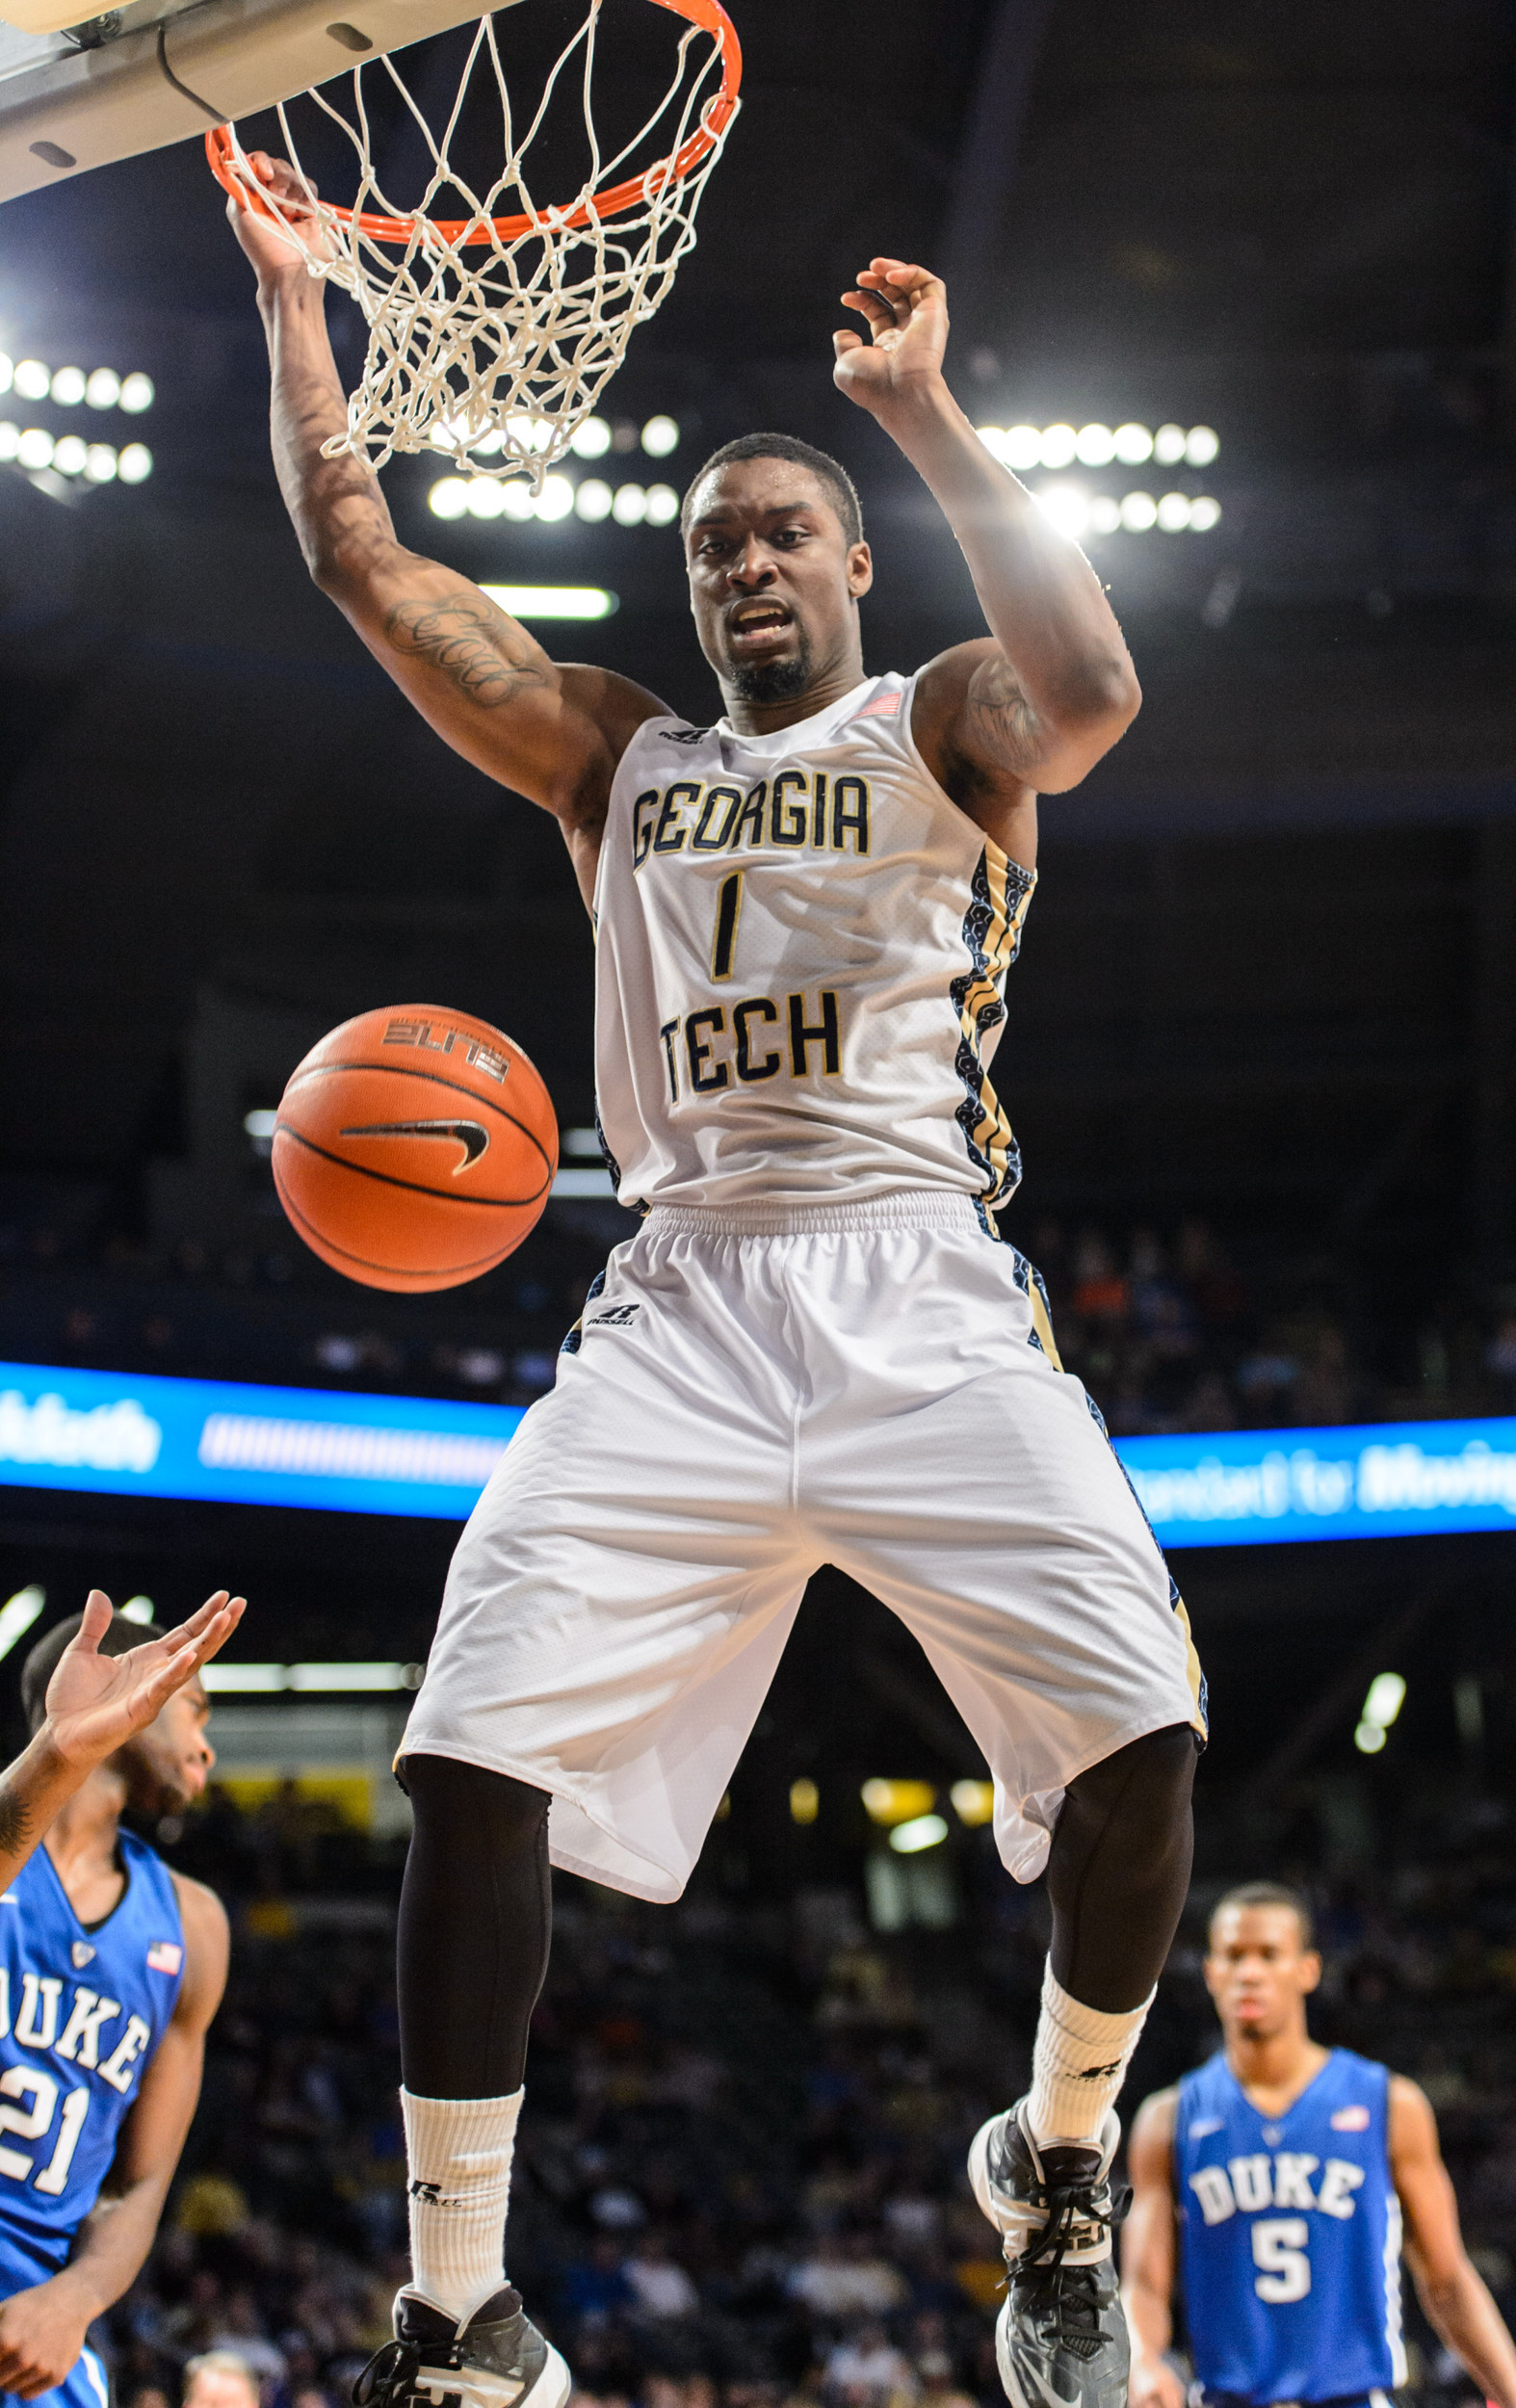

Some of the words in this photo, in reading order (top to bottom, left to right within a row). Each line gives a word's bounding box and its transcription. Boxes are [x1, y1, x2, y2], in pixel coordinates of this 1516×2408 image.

[633, 768, 871, 874] GEORGIA
[710, 870, 745, 982] 1
[381, 1021, 510, 1085] ELITE
[660, 989, 842, 1107] TECH
[0, 2064, 91, 2196] 21
[1188, 2151, 1366, 2227] DUKE
[1251, 2217, 1312, 2304] 5
